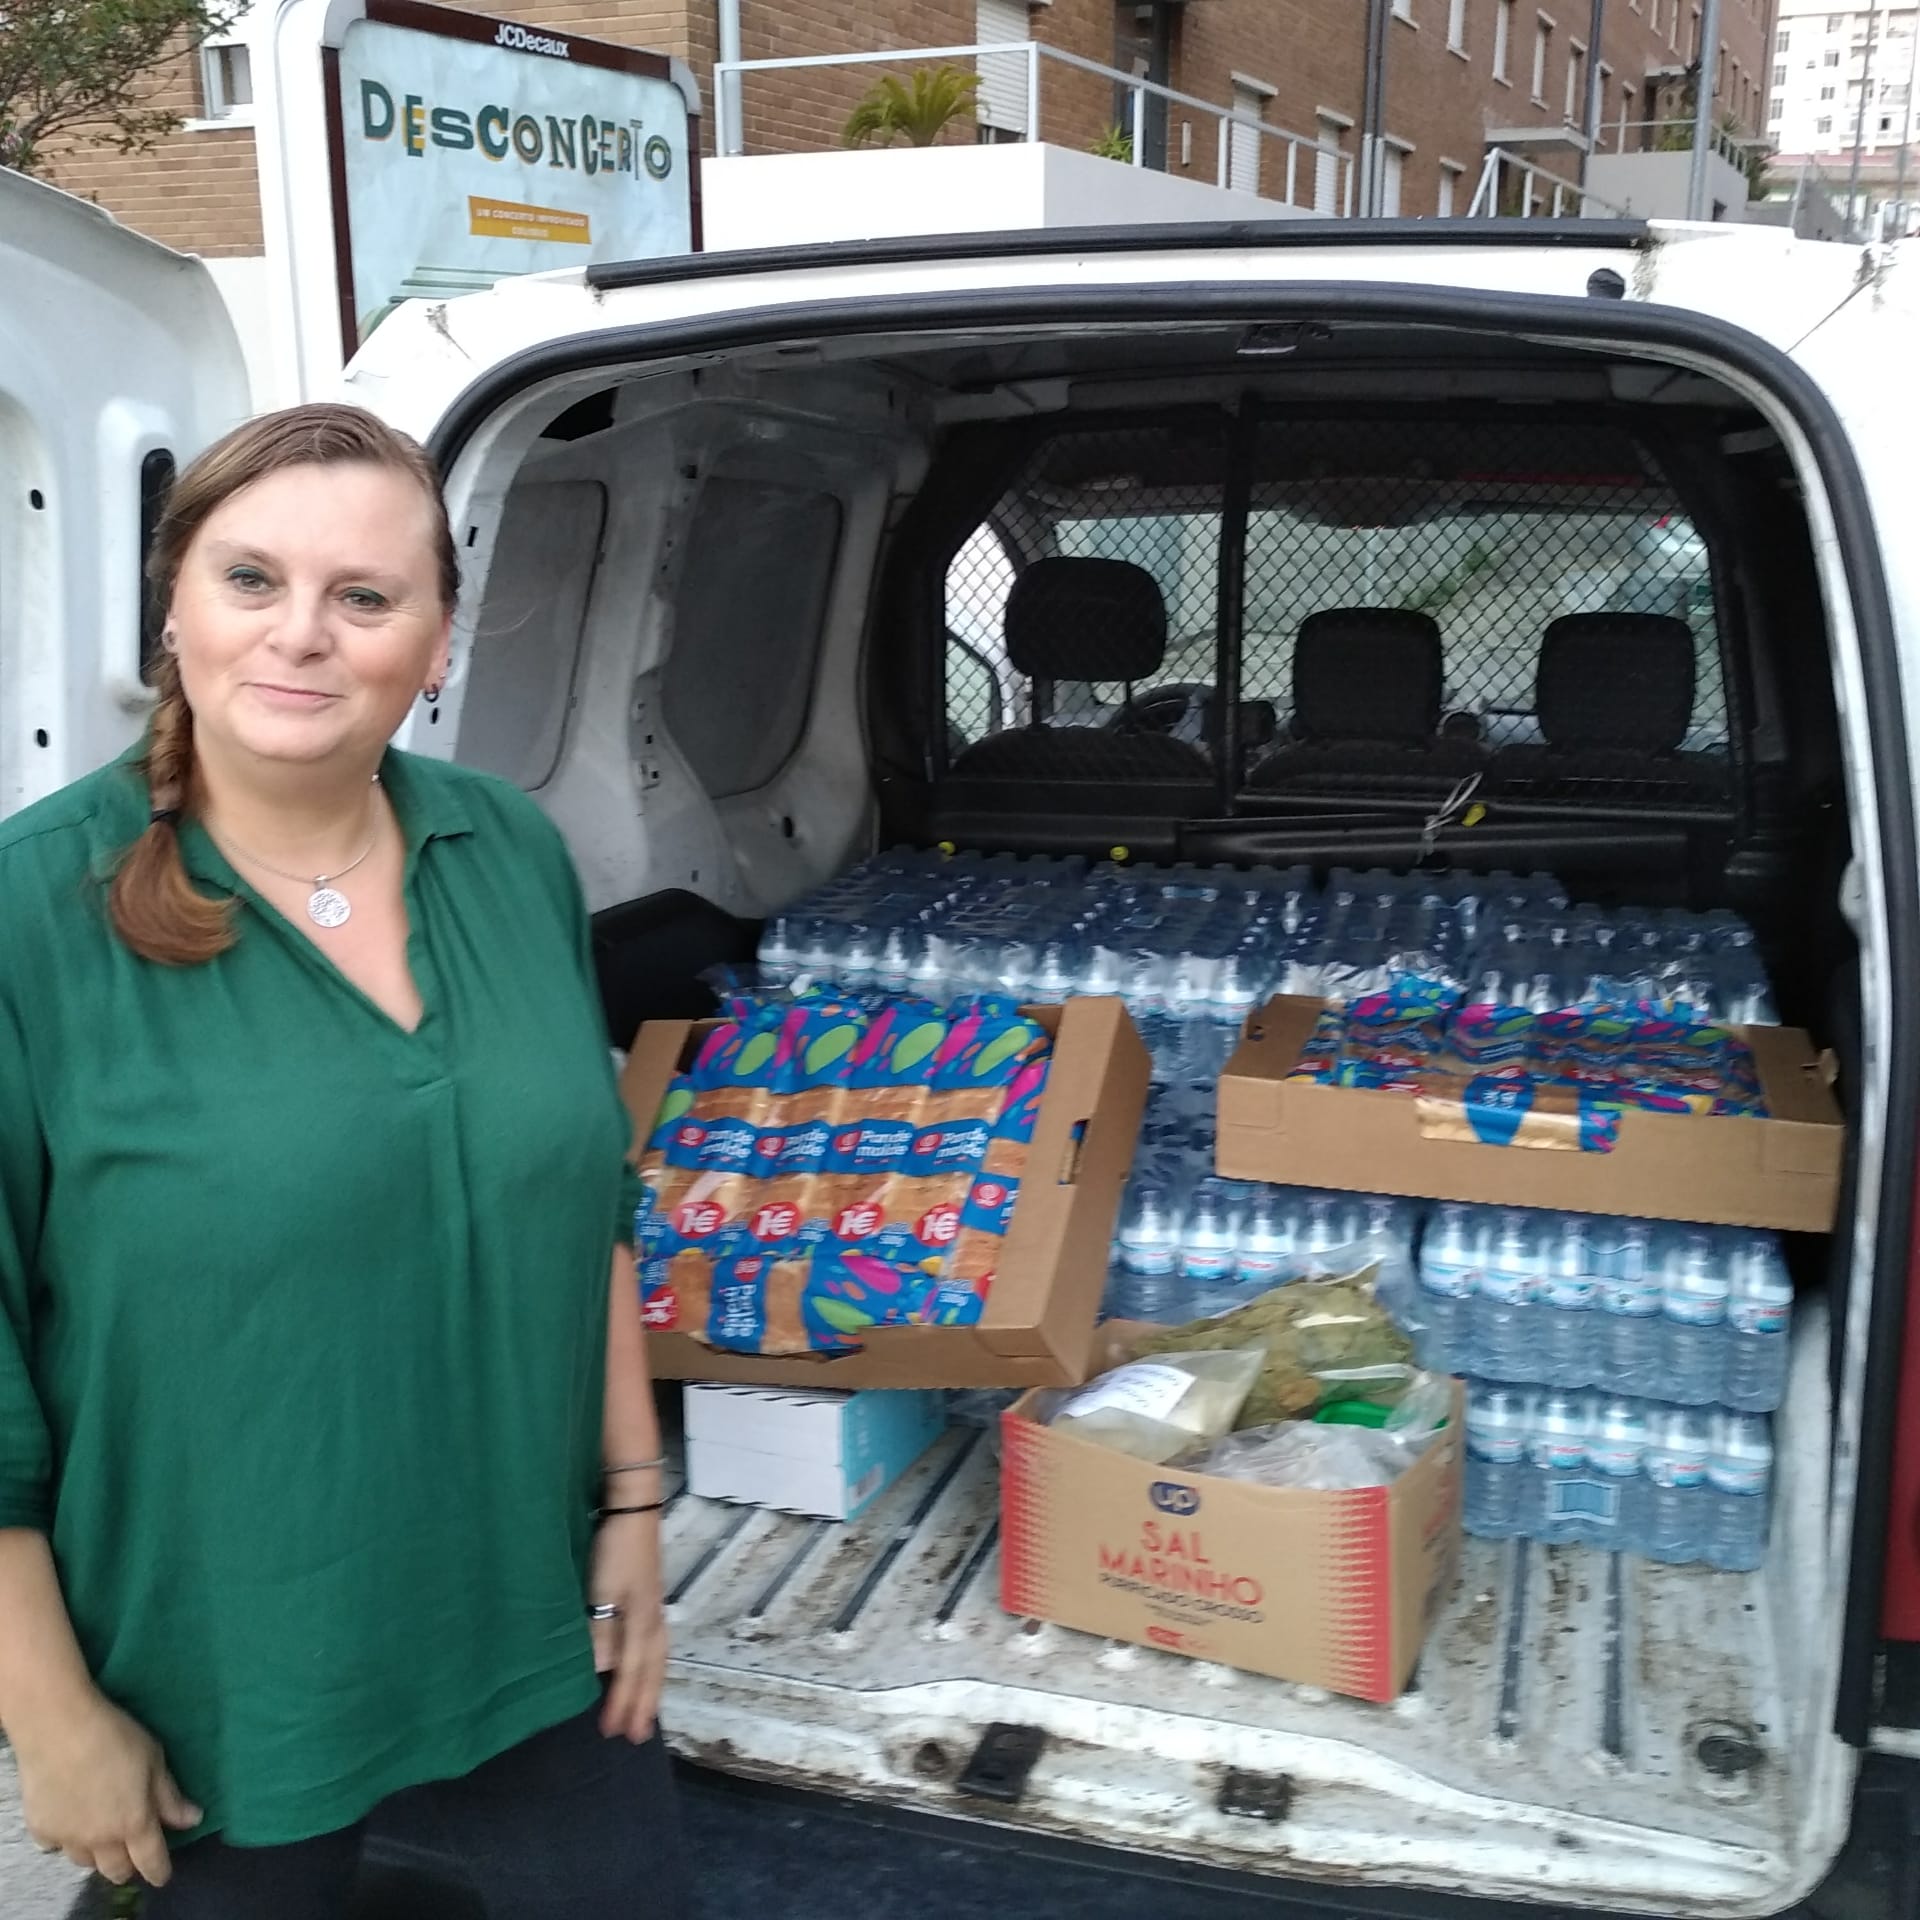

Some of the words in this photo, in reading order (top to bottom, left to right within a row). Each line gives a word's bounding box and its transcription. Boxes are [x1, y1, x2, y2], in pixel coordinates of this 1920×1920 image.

[495, 23, 569, 58] JCDecaux
[360, 78, 672, 181] DESCONCERTO
[679, 1207, 720, 1234] 1€
[757, 1209, 796, 1236] 1€
[838, 1209, 878, 1236] 1€
[1140, 1520, 1210, 1564] SAL
[1098, 1543, 1264, 1606] MARINHO
